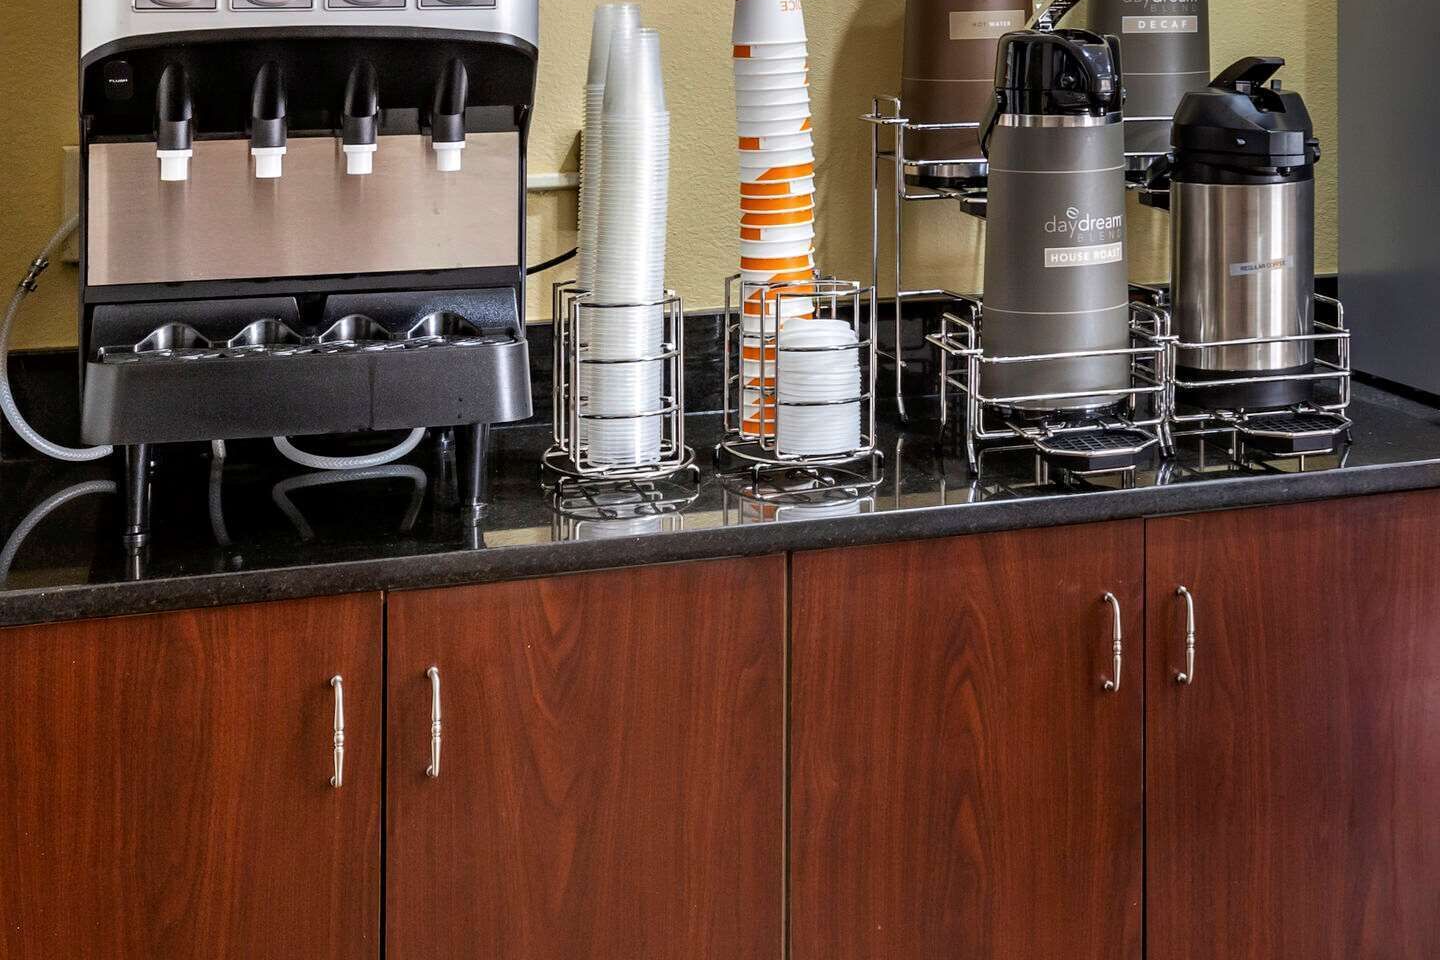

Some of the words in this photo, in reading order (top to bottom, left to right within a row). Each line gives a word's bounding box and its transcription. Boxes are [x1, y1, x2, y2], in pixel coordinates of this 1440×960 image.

[1137, 20, 1188, 29] DECAF
[1044, 213, 1122, 239] daydream
[1050, 251, 1089, 263] HOUSE
[1093, 247, 1121, 258] ROAST
